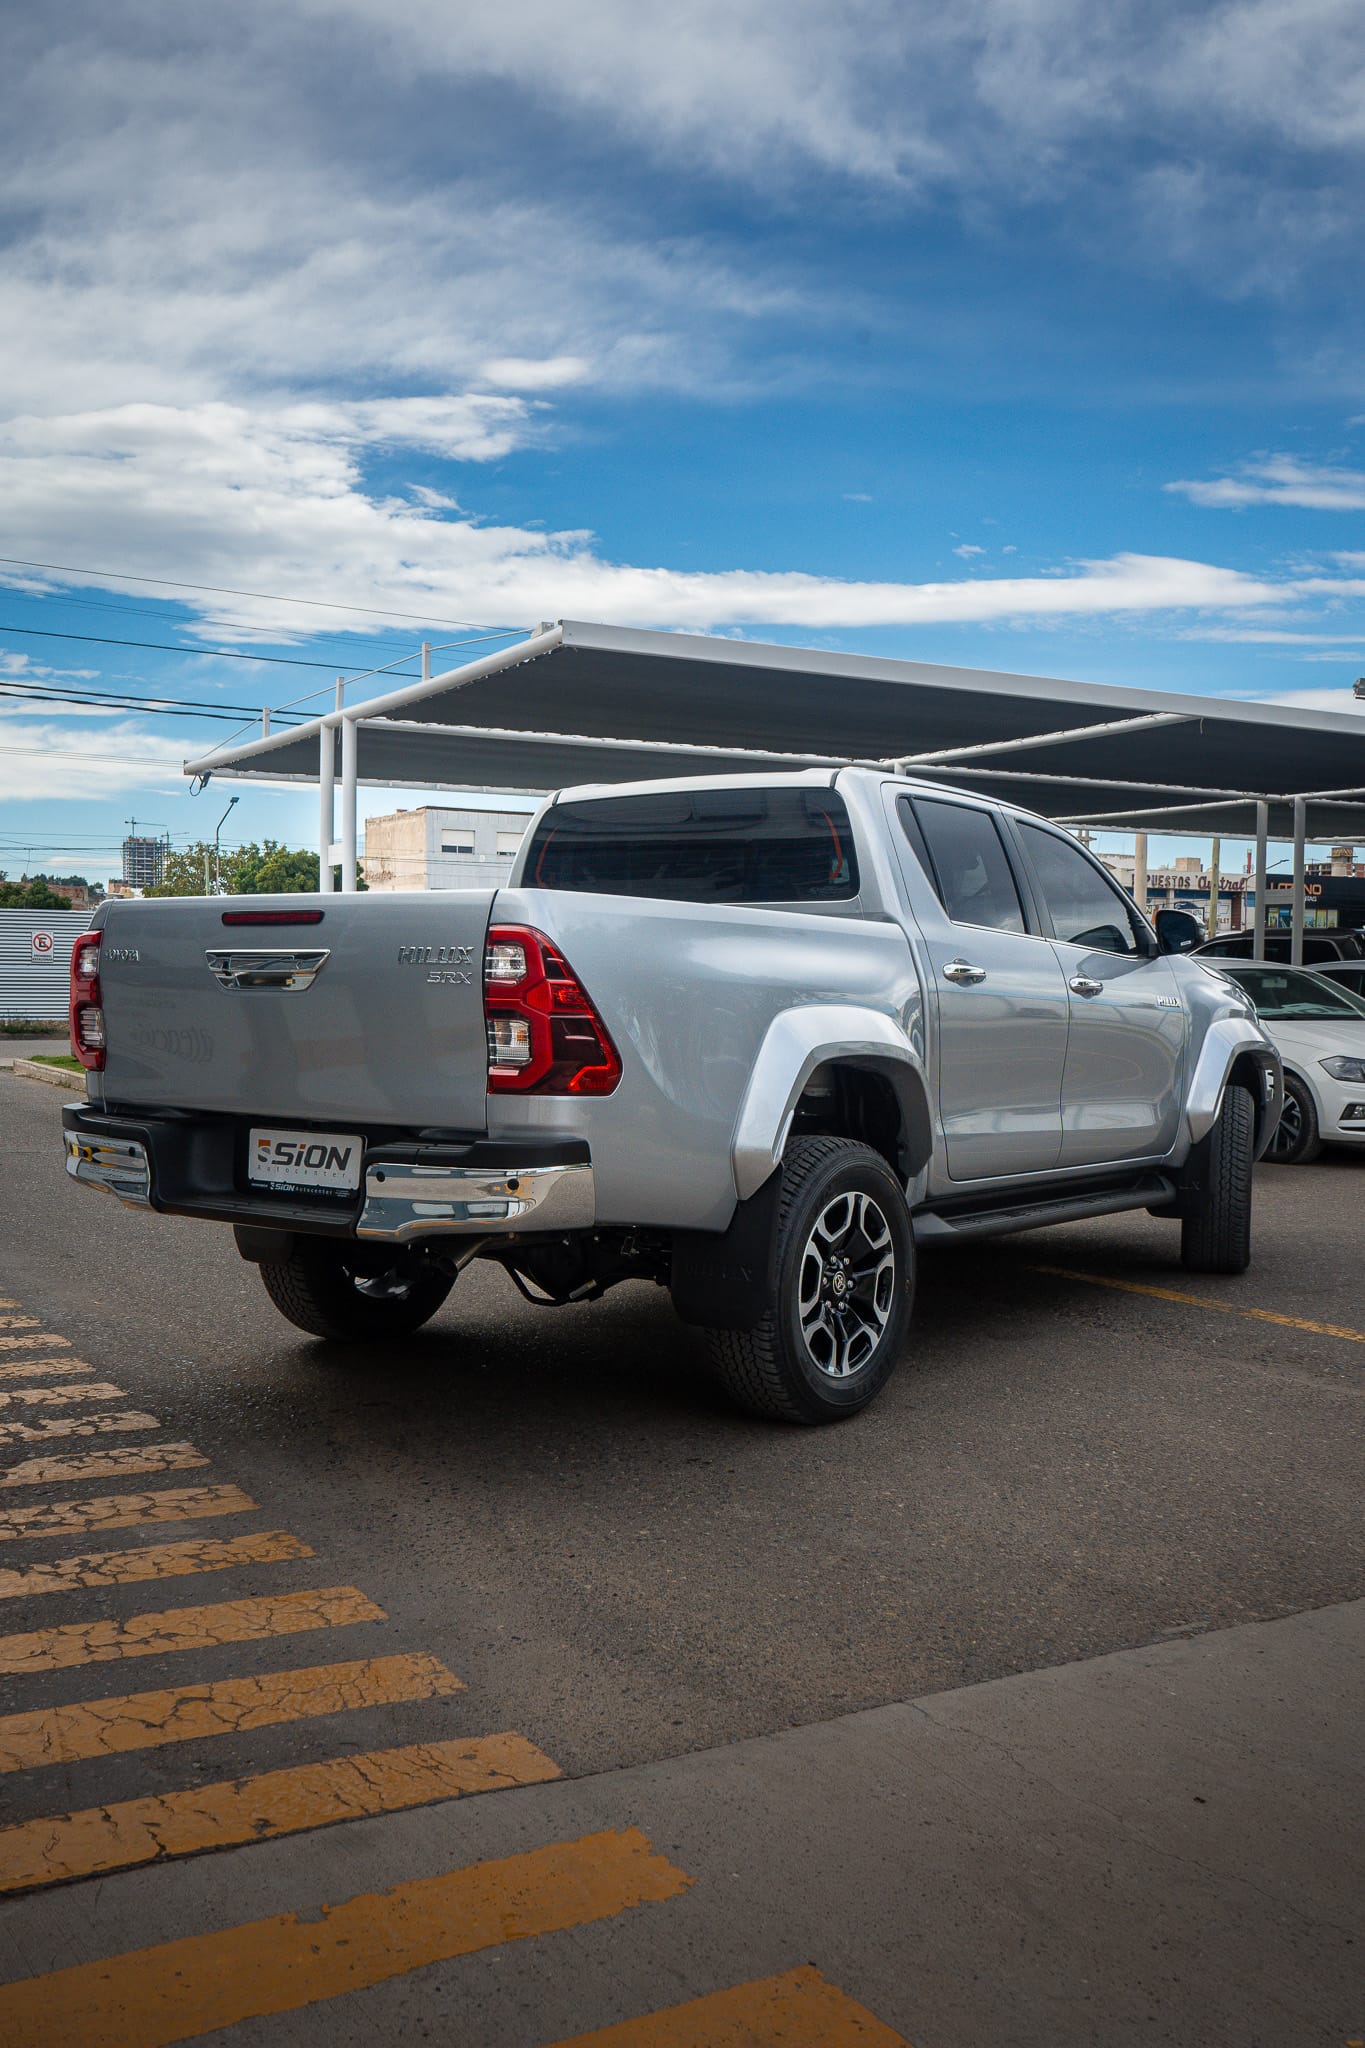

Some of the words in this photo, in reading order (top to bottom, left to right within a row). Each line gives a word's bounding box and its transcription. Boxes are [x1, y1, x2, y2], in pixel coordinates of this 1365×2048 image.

[397, 946, 475, 965] HILUX
[426, 971, 473, 985] SRX
[256, 1164, 347, 1178] Autocenter
